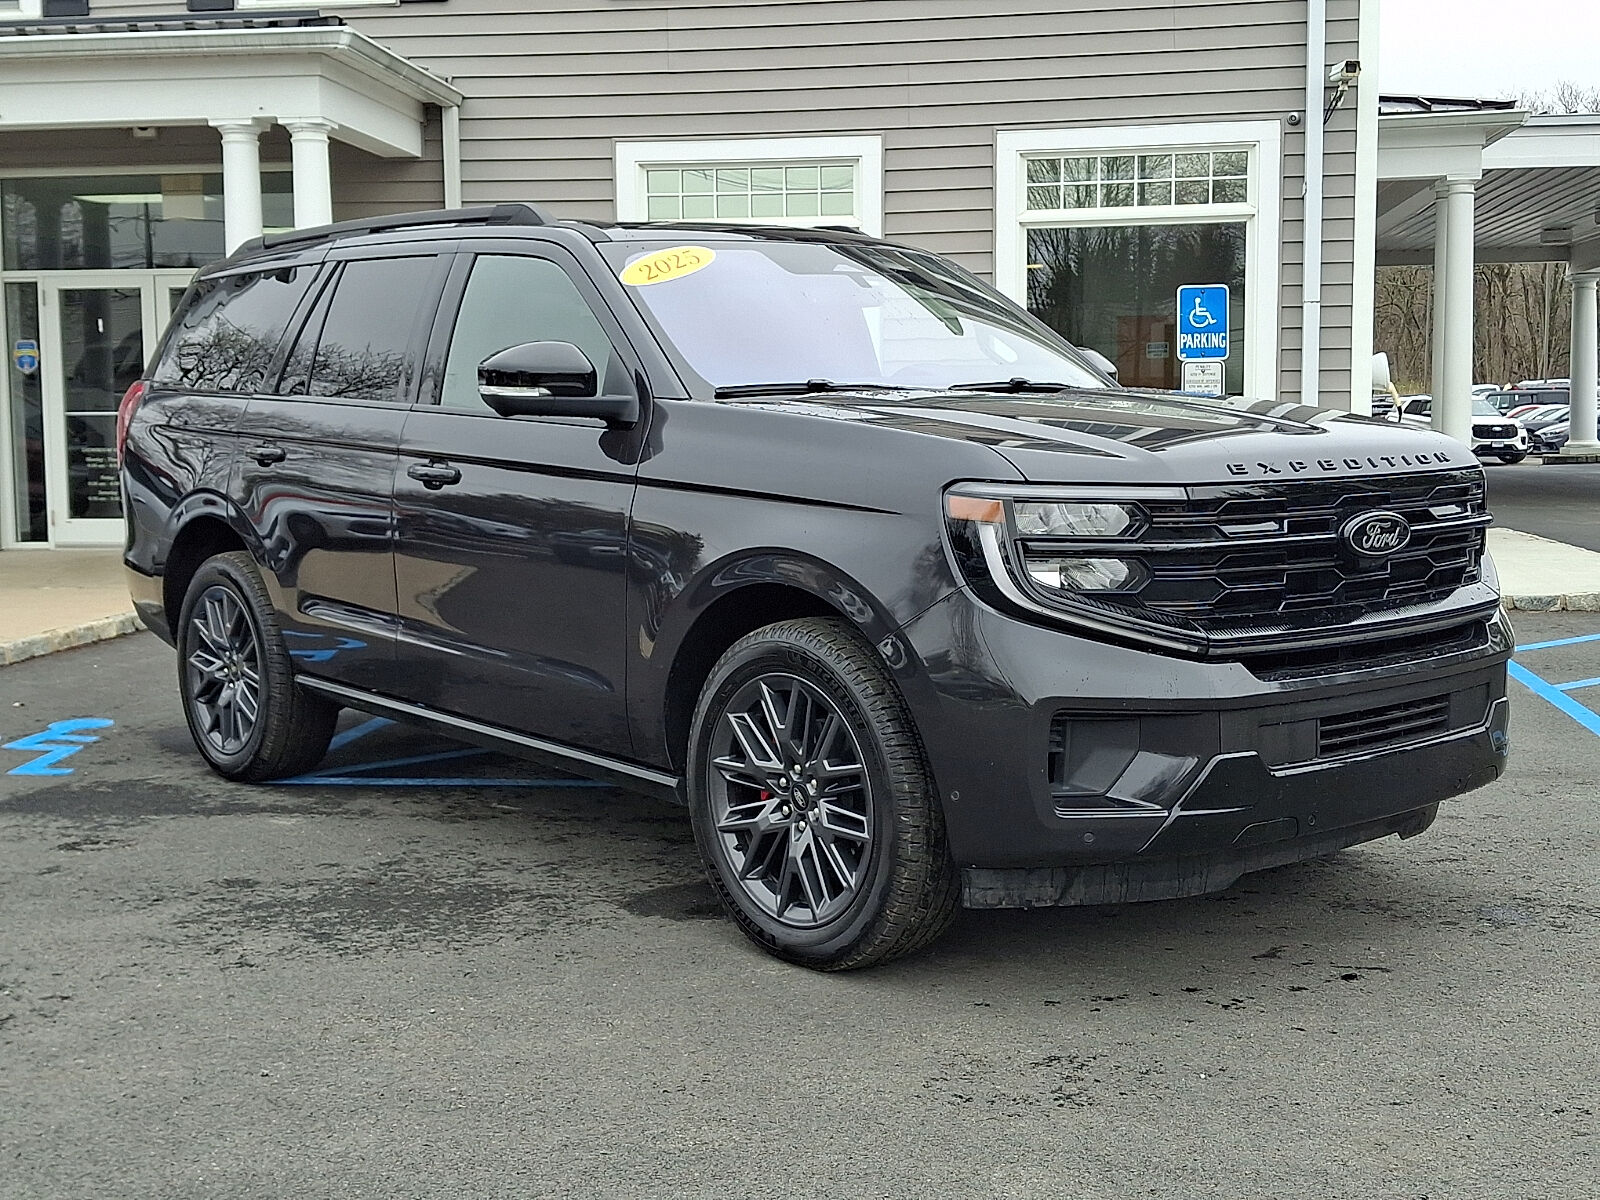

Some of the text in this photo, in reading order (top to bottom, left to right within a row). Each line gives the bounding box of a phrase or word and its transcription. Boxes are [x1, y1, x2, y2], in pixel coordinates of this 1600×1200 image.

[639, 250, 700, 280] 2025
[1181, 333, 1226, 348] PARKING
[1226, 451, 1451, 475] EXPEDITION
[1362, 521, 1400, 549] Ford
[806, 659, 864, 727] MICHELIN
